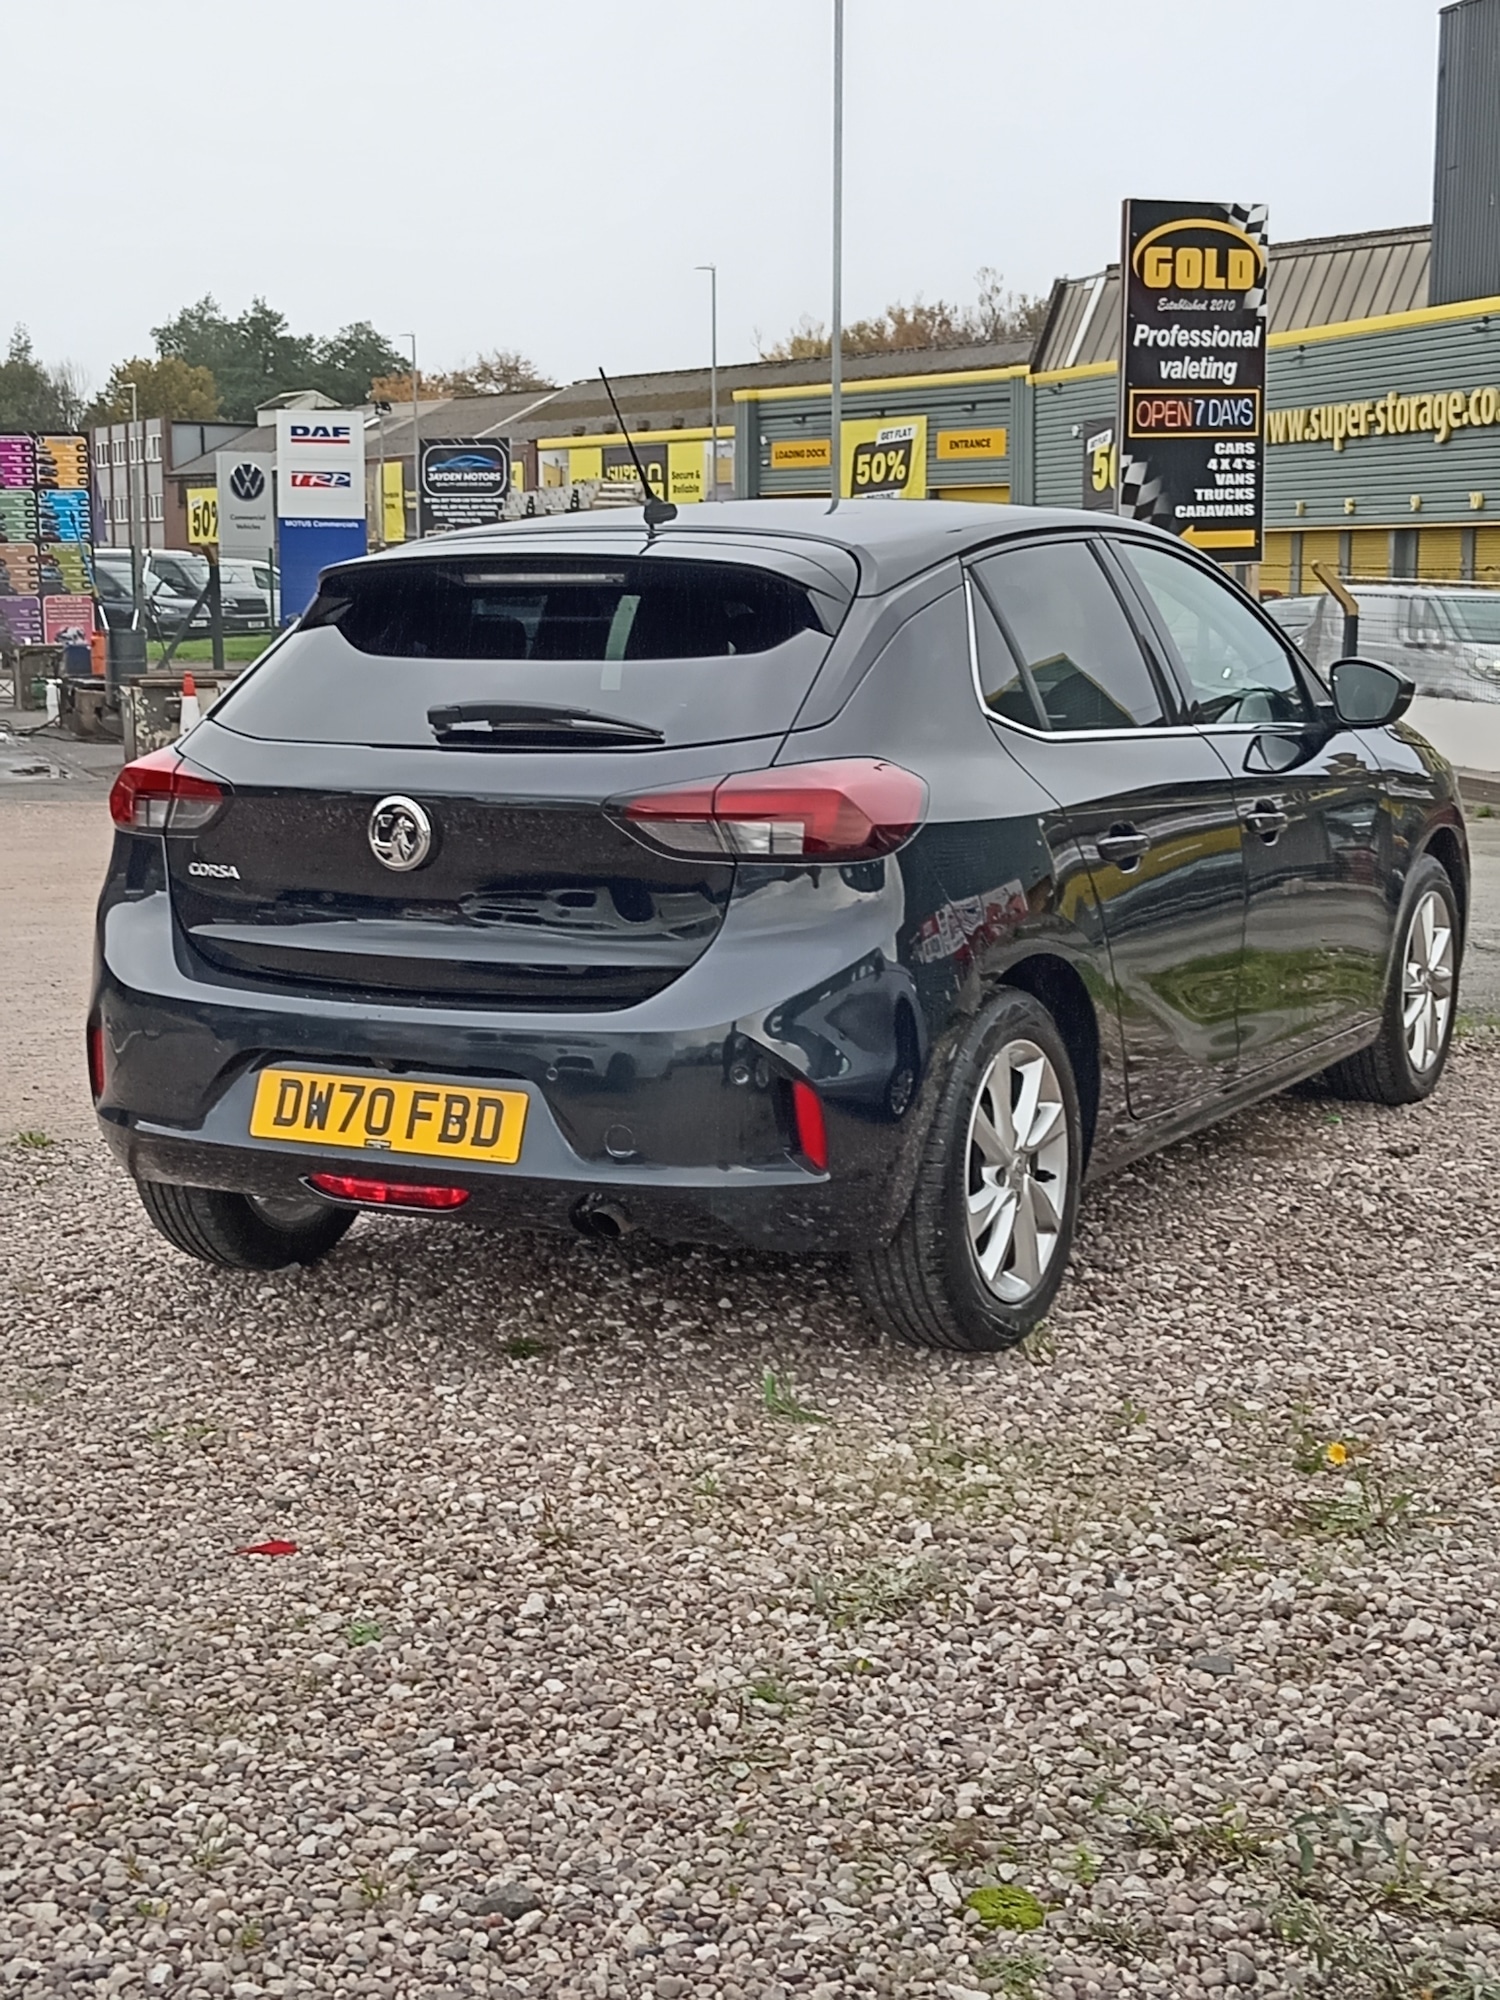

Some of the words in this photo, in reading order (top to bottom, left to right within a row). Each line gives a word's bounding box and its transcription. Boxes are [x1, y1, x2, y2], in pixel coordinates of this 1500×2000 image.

[1143, 246, 1255, 290] GOLD
[1157, 297, 1208, 312] Established
[1209, 299, 1236, 312] 2010
[1133, 323, 1262, 348] Professional
[1160, 356, 1238, 385] valeting
[1136, 400, 1192, 427] OPEN
[1194, 399, 1205, 426] 7
[1208, 398, 1253, 426] DAYS
[1266, 387, 1500, 452] ww.super-storage.co.
[290, 425, 351, 438] DAF
[880, 430, 894, 441] GET
[895, 427, 912, 439] FLAT
[949, 438, 991, 450] ENTRANCE
[1214, 442, 1256, 455] CARS
[775, 449, 805, 460] LOADING
[806, 447, 827, 459] DOCK
[856, 449, 907, 485] 50%
[1207, 458, 1218, 471] 4
[1220, 459, 1231, 471] X
[1232, 458, 1256, 471] 4's
[291, 472, 351, 487] TRP
[427, 472, 462, 481] JAYDEN
[463, 472, 501, 481] MOTORS
[671, 471, 694, 480] Secure
[1215, 473, 1256, 486] VANS
[673, 484, 700, 494] Reliable
[1194, 488, 1256, 501] TRUCKS
[1175, 504, 1256, 518] CARAVANS
[285, 520, 312, 528] MOTUS
[313, 520, 359, 529] Commercials
[188, 862, 240, 880] CORSA
[273, 1078, 396, 1136] DW70
[405, 1090, 504, 1148] FBD
